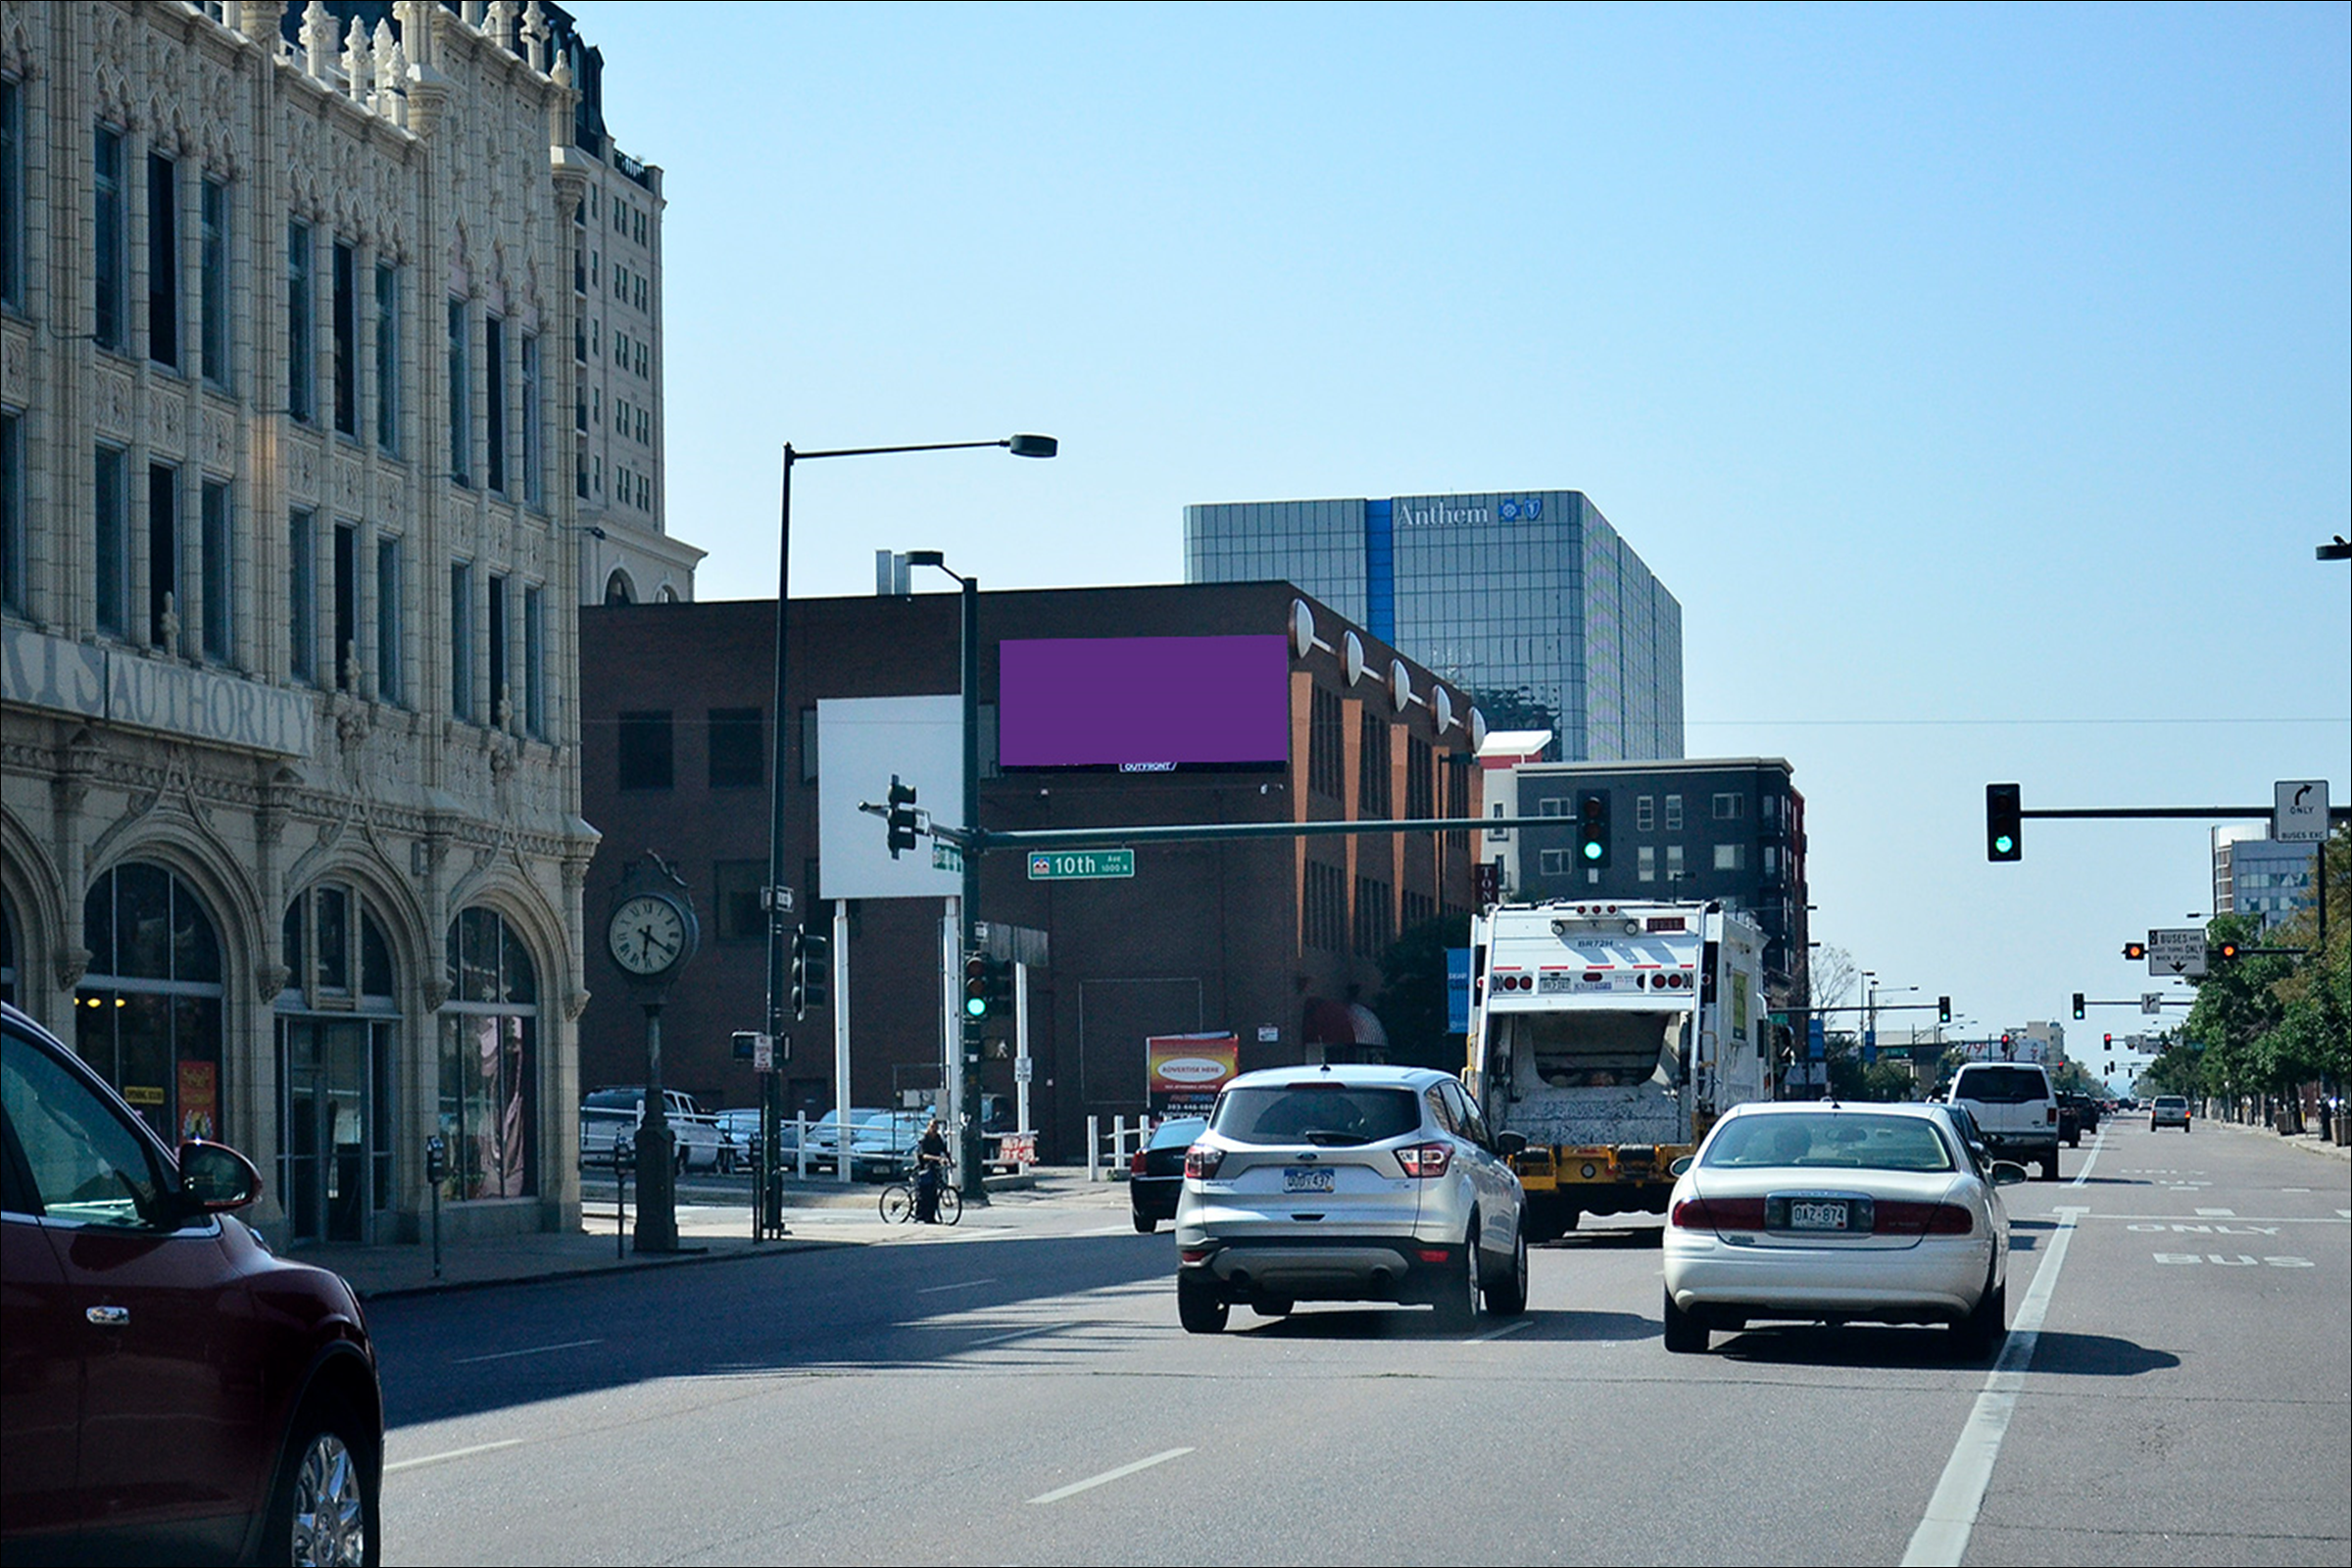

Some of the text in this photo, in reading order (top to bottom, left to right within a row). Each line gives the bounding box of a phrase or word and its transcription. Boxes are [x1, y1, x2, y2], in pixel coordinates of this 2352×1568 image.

[1397, 502, 1489, 525] Anthem
[112, 658, 313, 757] AUTHORITY
[1124, 762, 1172, 772] OUTFRONT
[1055, 856, 1096, 874] 10th
[2160, 934, 2187, 944] BUSES
[2185, 945, 2204, 954] ONLY
[2126, 1224, 2281, 1235] ONLY
[2152, 1252, 2316, 1268] BUS
